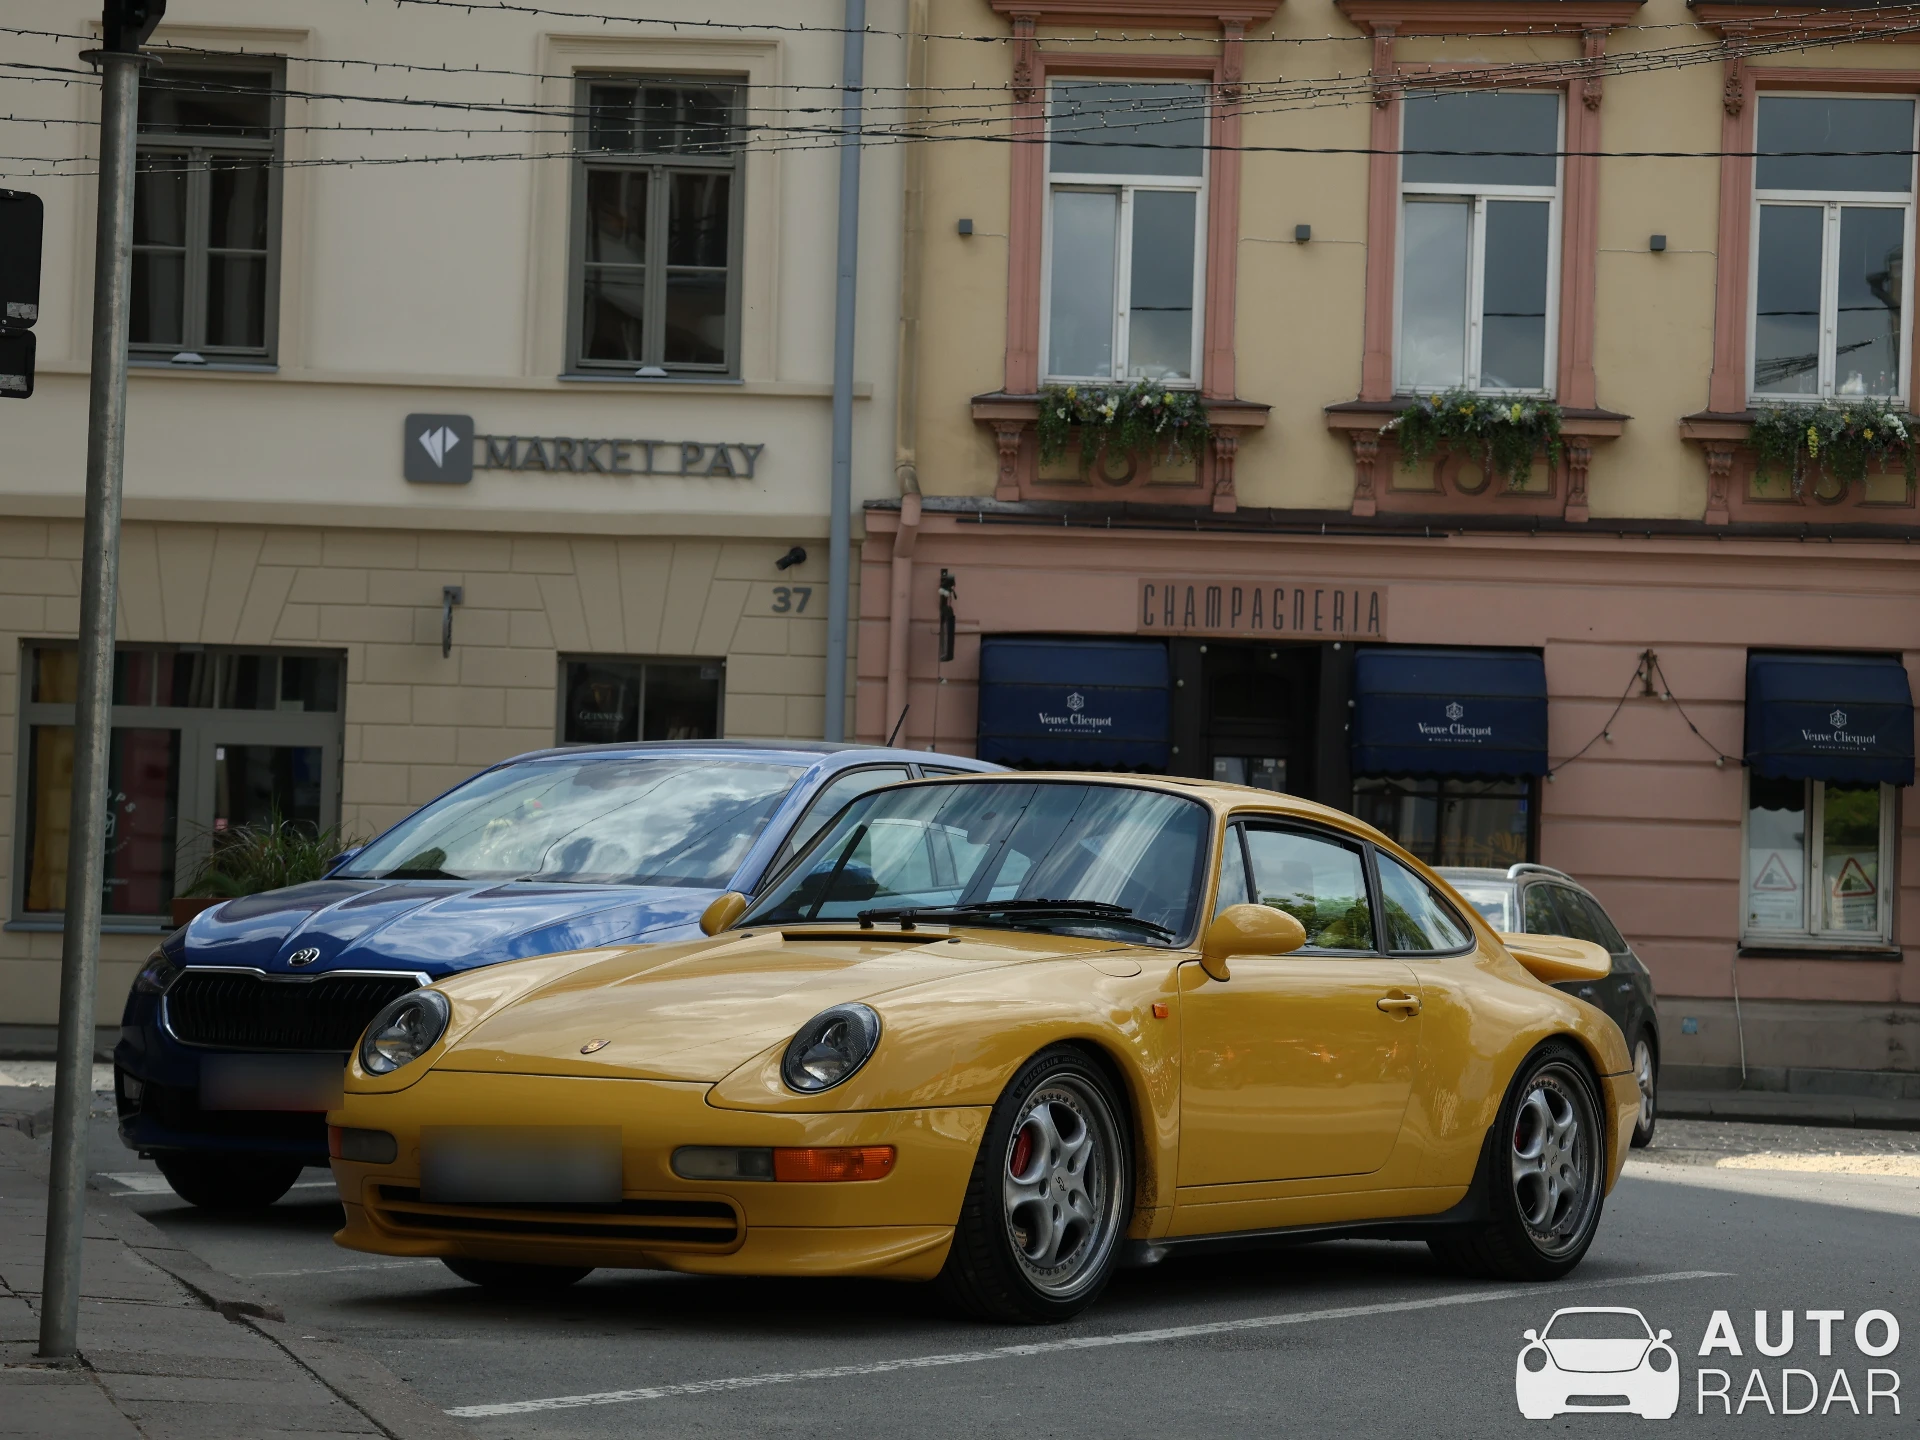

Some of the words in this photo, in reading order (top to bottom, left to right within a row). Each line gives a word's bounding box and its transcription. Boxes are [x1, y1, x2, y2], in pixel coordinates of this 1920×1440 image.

[486, 434, 664, 475] MARKET
[681, 441, 764, 479] PAY
[771, 586, 812, 613] 37
[1143, 583, 1381, 634] CHAMPAGNERIA
[1038, 712, 1068, 724] Veuve
[1070, 713, 1112, 728] Clicquot
[1418, 722, 1448, 734] Veuve
[1449, 723, 1492, 738] Clicquot
[1802, 729, 1832, 741] Veuve
[1833, 730, 1876, 745] Clicquot
[1023, 1056, 1059, 1085] MICHELIN
